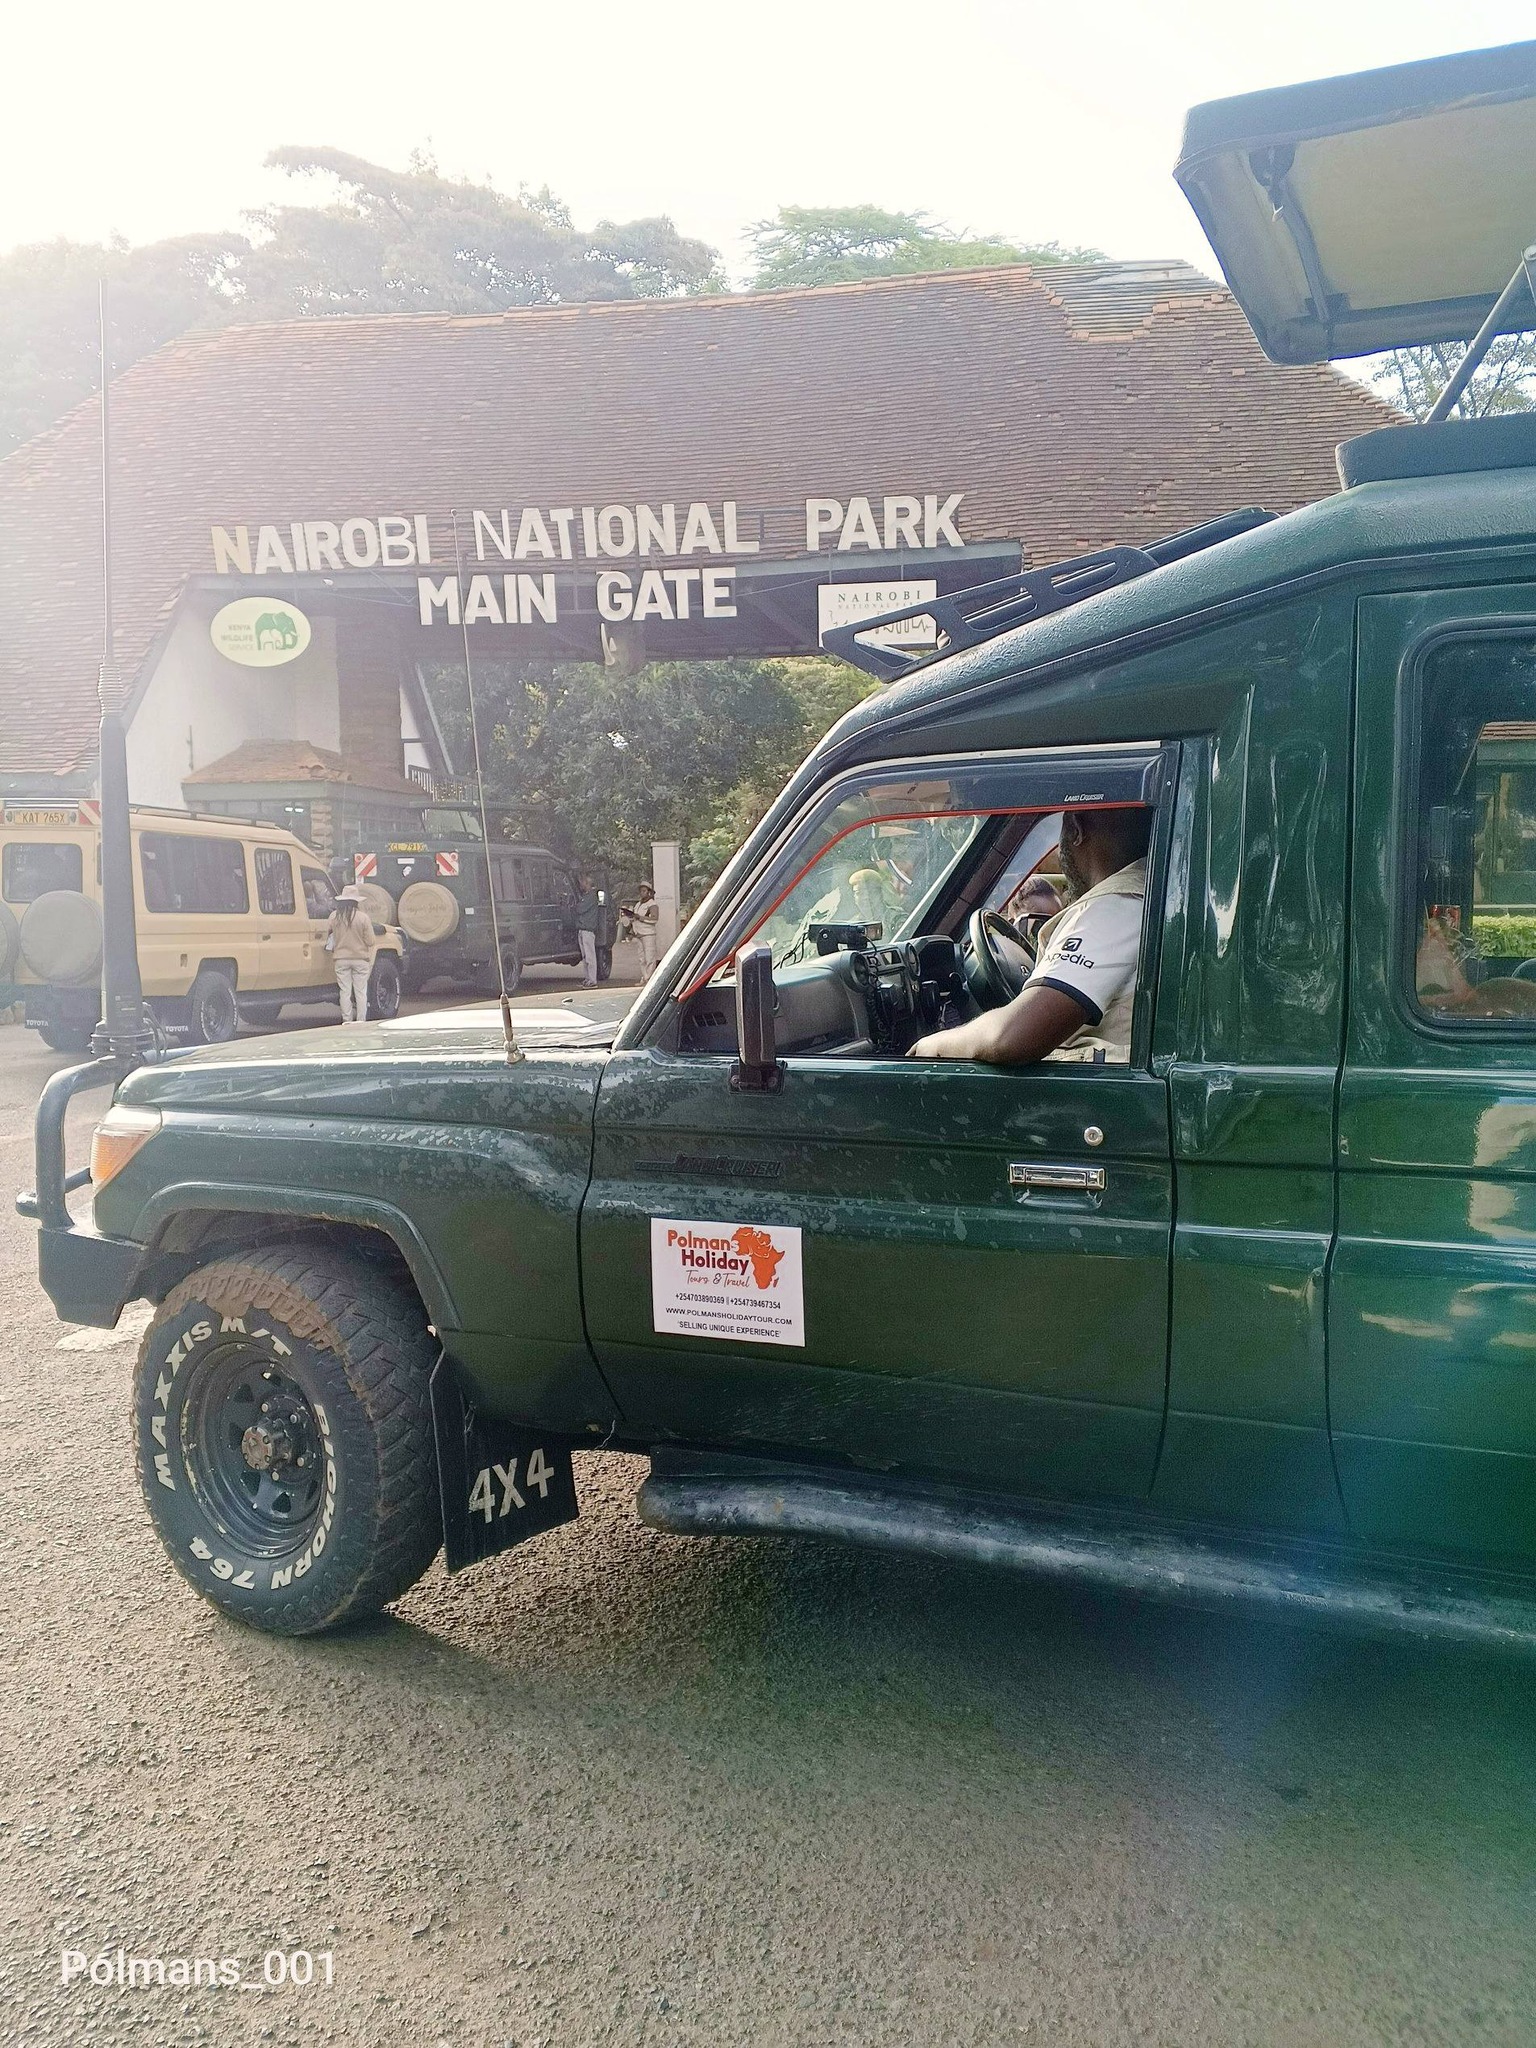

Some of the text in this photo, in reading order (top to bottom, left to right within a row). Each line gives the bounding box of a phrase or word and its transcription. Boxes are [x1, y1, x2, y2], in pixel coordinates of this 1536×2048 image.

[211, 493, 966, 575] NAIROBI NATIONAL PARK
[417, 567, 737, 625] MAIN GATE
[838, 590, 921, 602] NAIROBI
[22, 812, 65, 823] KAT 765X
[26, 1019, 49, 1027] TOYOTA
[667, 1230, 740, 1252] Polmans
[682, 1249, 749, 1275] Holiday
[686, 1270, 750, 1288] Tours & Travel
[675, 1293, 725, 1304] +254703890369
[666, 1307, 792, 1325] WWW.POLMANSHOLIDAYTOUR.COM
[709, 1324, 735, 1334] UNIQUE
[152, 1320, 212, 1491] MAXXIS
[468, 1448, 555, 1524] 4X4
[189, 1403, 337, 1590] BIGHORN 764
